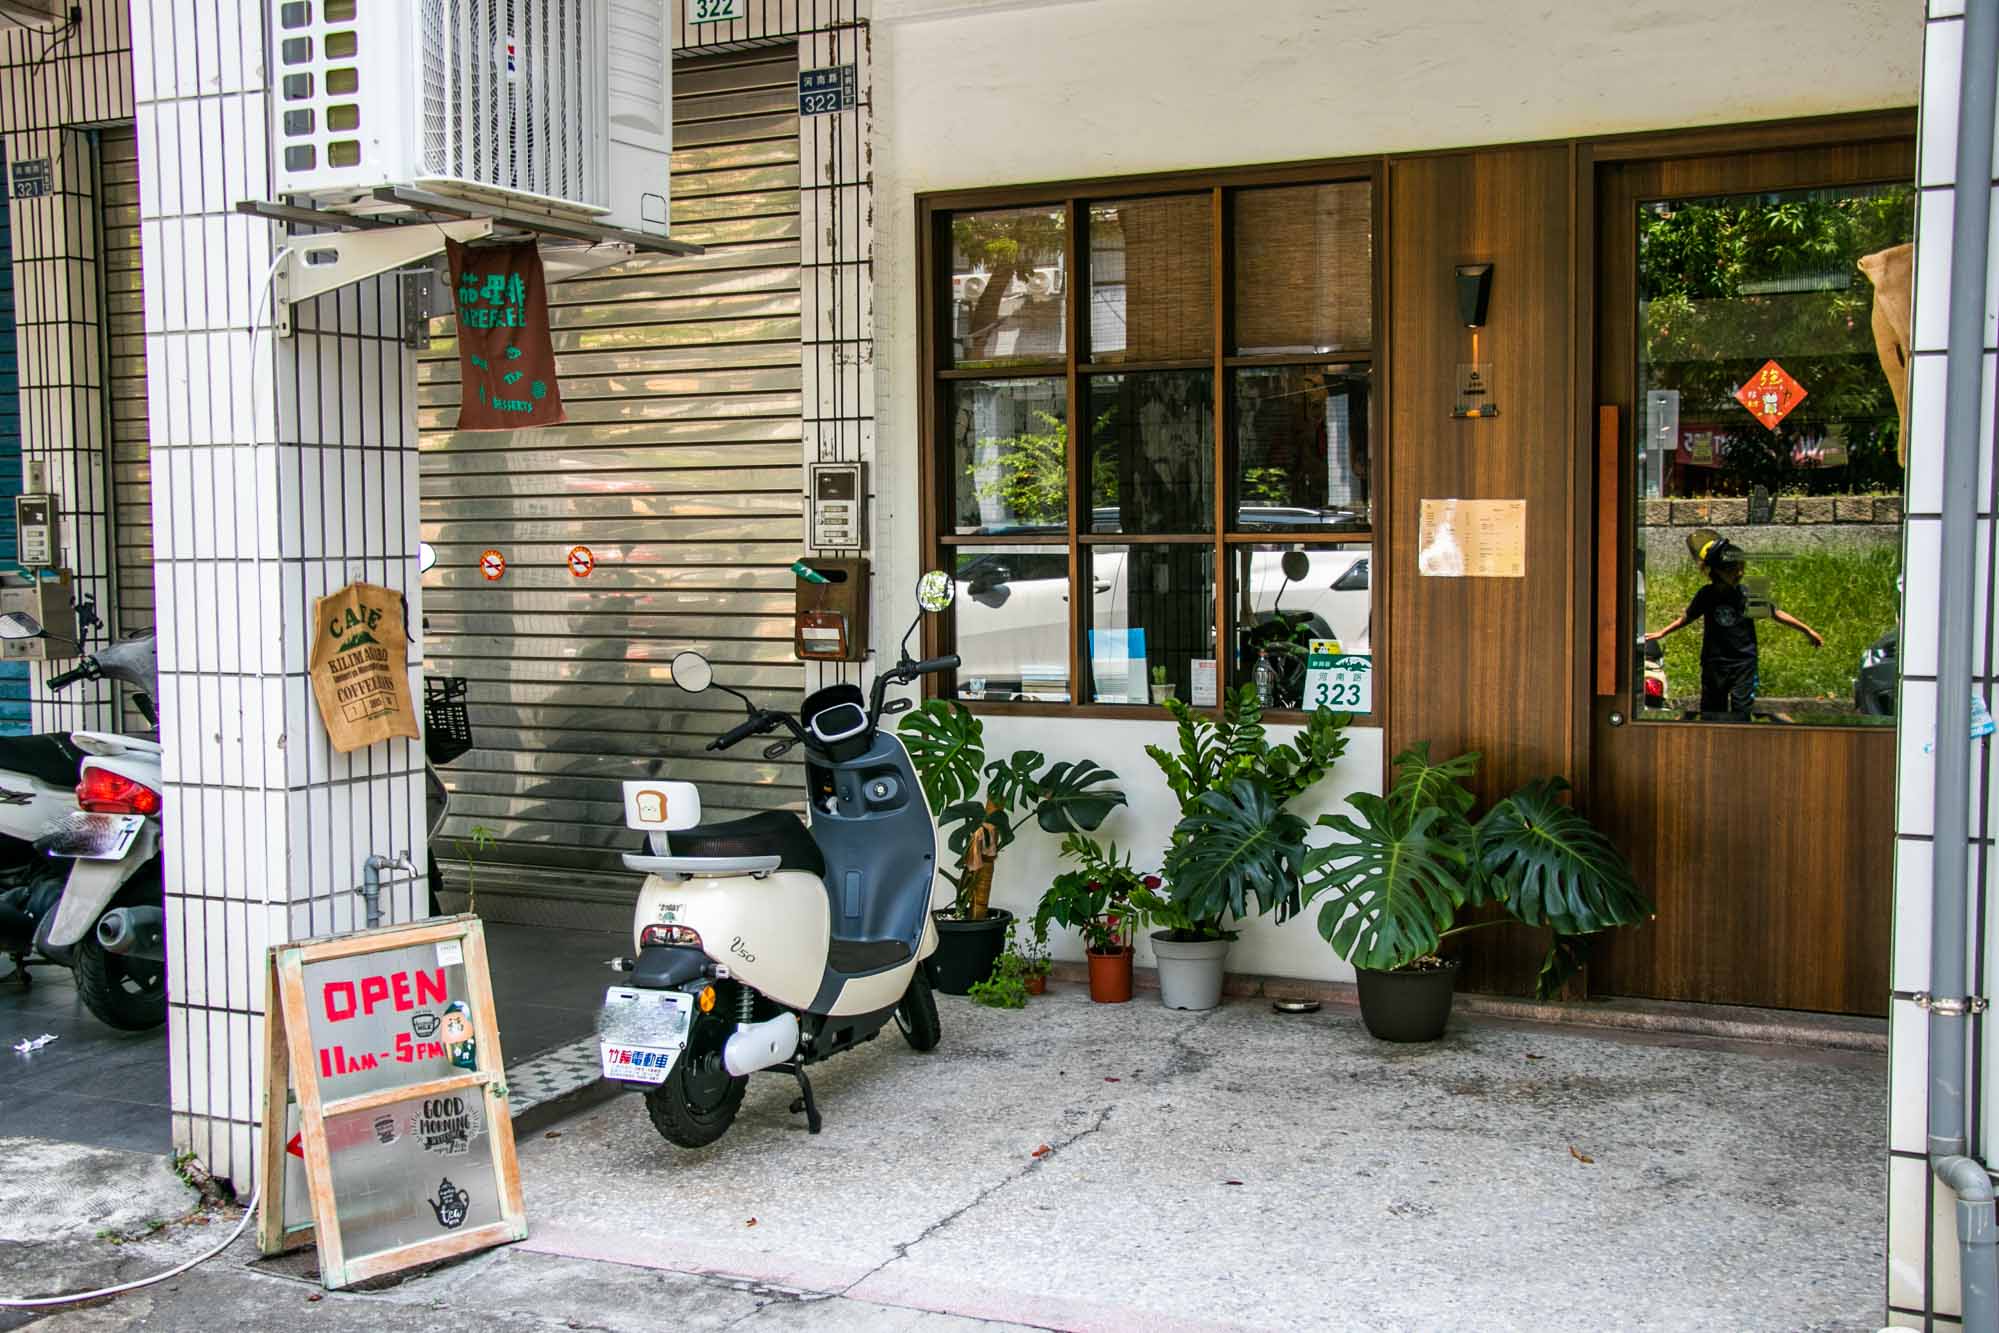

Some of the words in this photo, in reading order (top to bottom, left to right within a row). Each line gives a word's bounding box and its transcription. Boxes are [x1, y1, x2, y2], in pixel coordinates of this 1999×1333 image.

[697, 0, 734, 18] 322
[803, 73, 838, 88] 河南路
[804, 93, 836, 113] 322
[17, 181, 38, 197] 321
[1318, 672, 1362, 682] 河南路
[1315, 683, 1361, 706] 323
[323, 967, 448, 1023] OPEN
[423, 1097, 465, 1119] GOOD
[420, 1114, 471, 1135] MORNING
